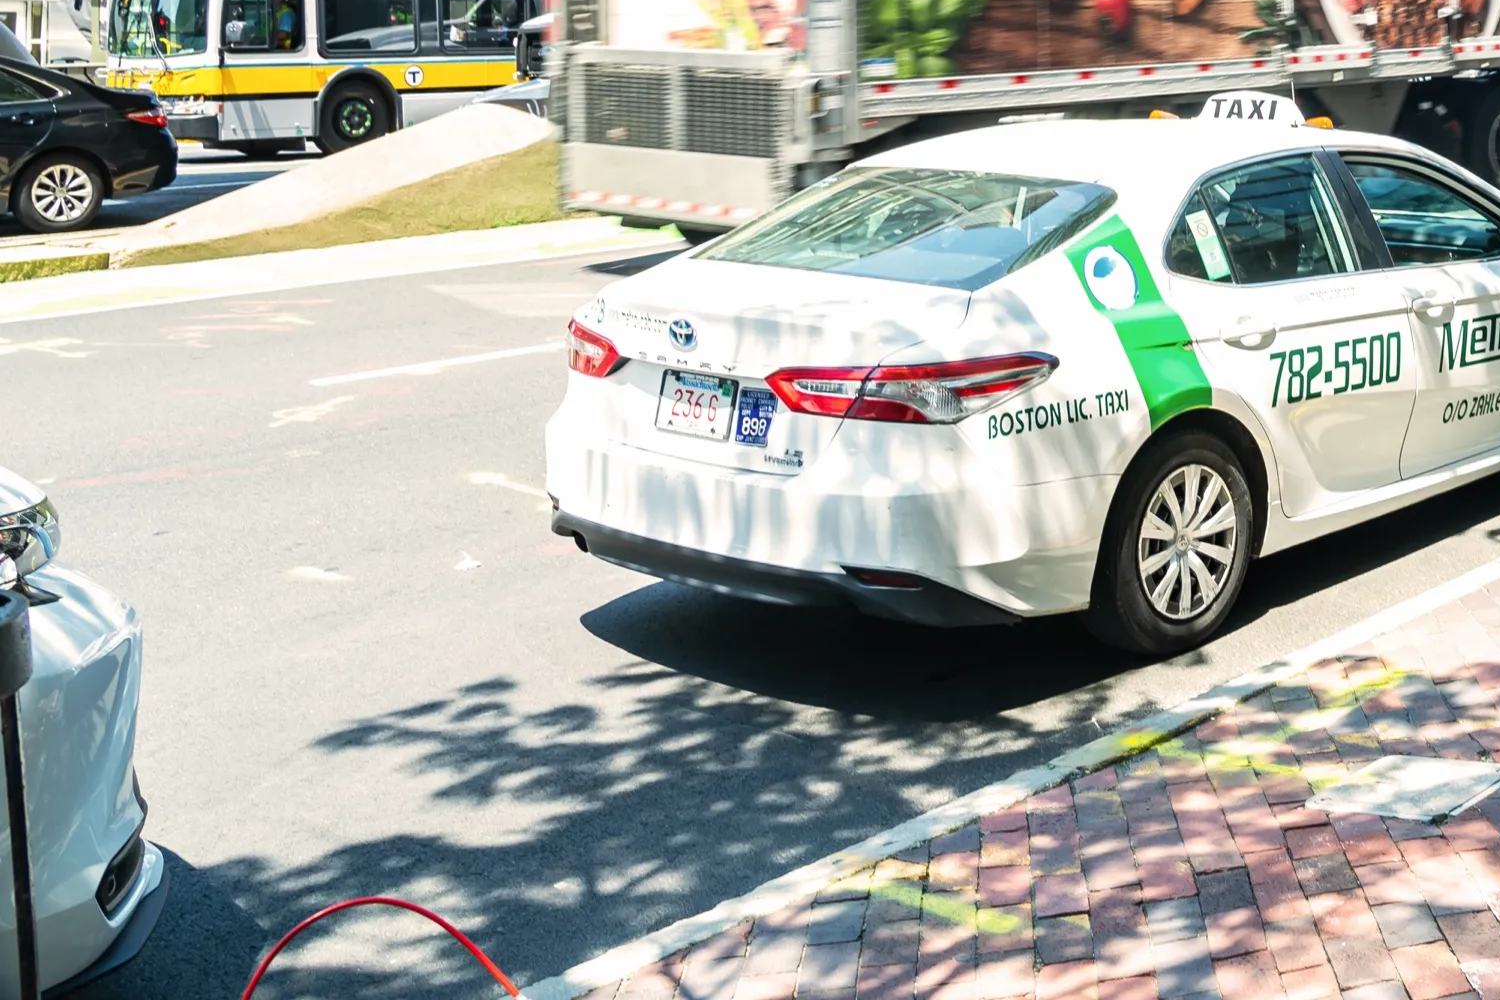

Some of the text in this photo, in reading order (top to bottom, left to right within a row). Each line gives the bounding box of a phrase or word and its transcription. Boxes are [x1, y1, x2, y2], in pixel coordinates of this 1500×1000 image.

[1211, 99, 1278, 120] TAXI
[988, 389, 1129, 440] BOSTON LIC. TAXI
[1442, 400, 1469, 424] O/O
[741, 416, 767, 437] 898
